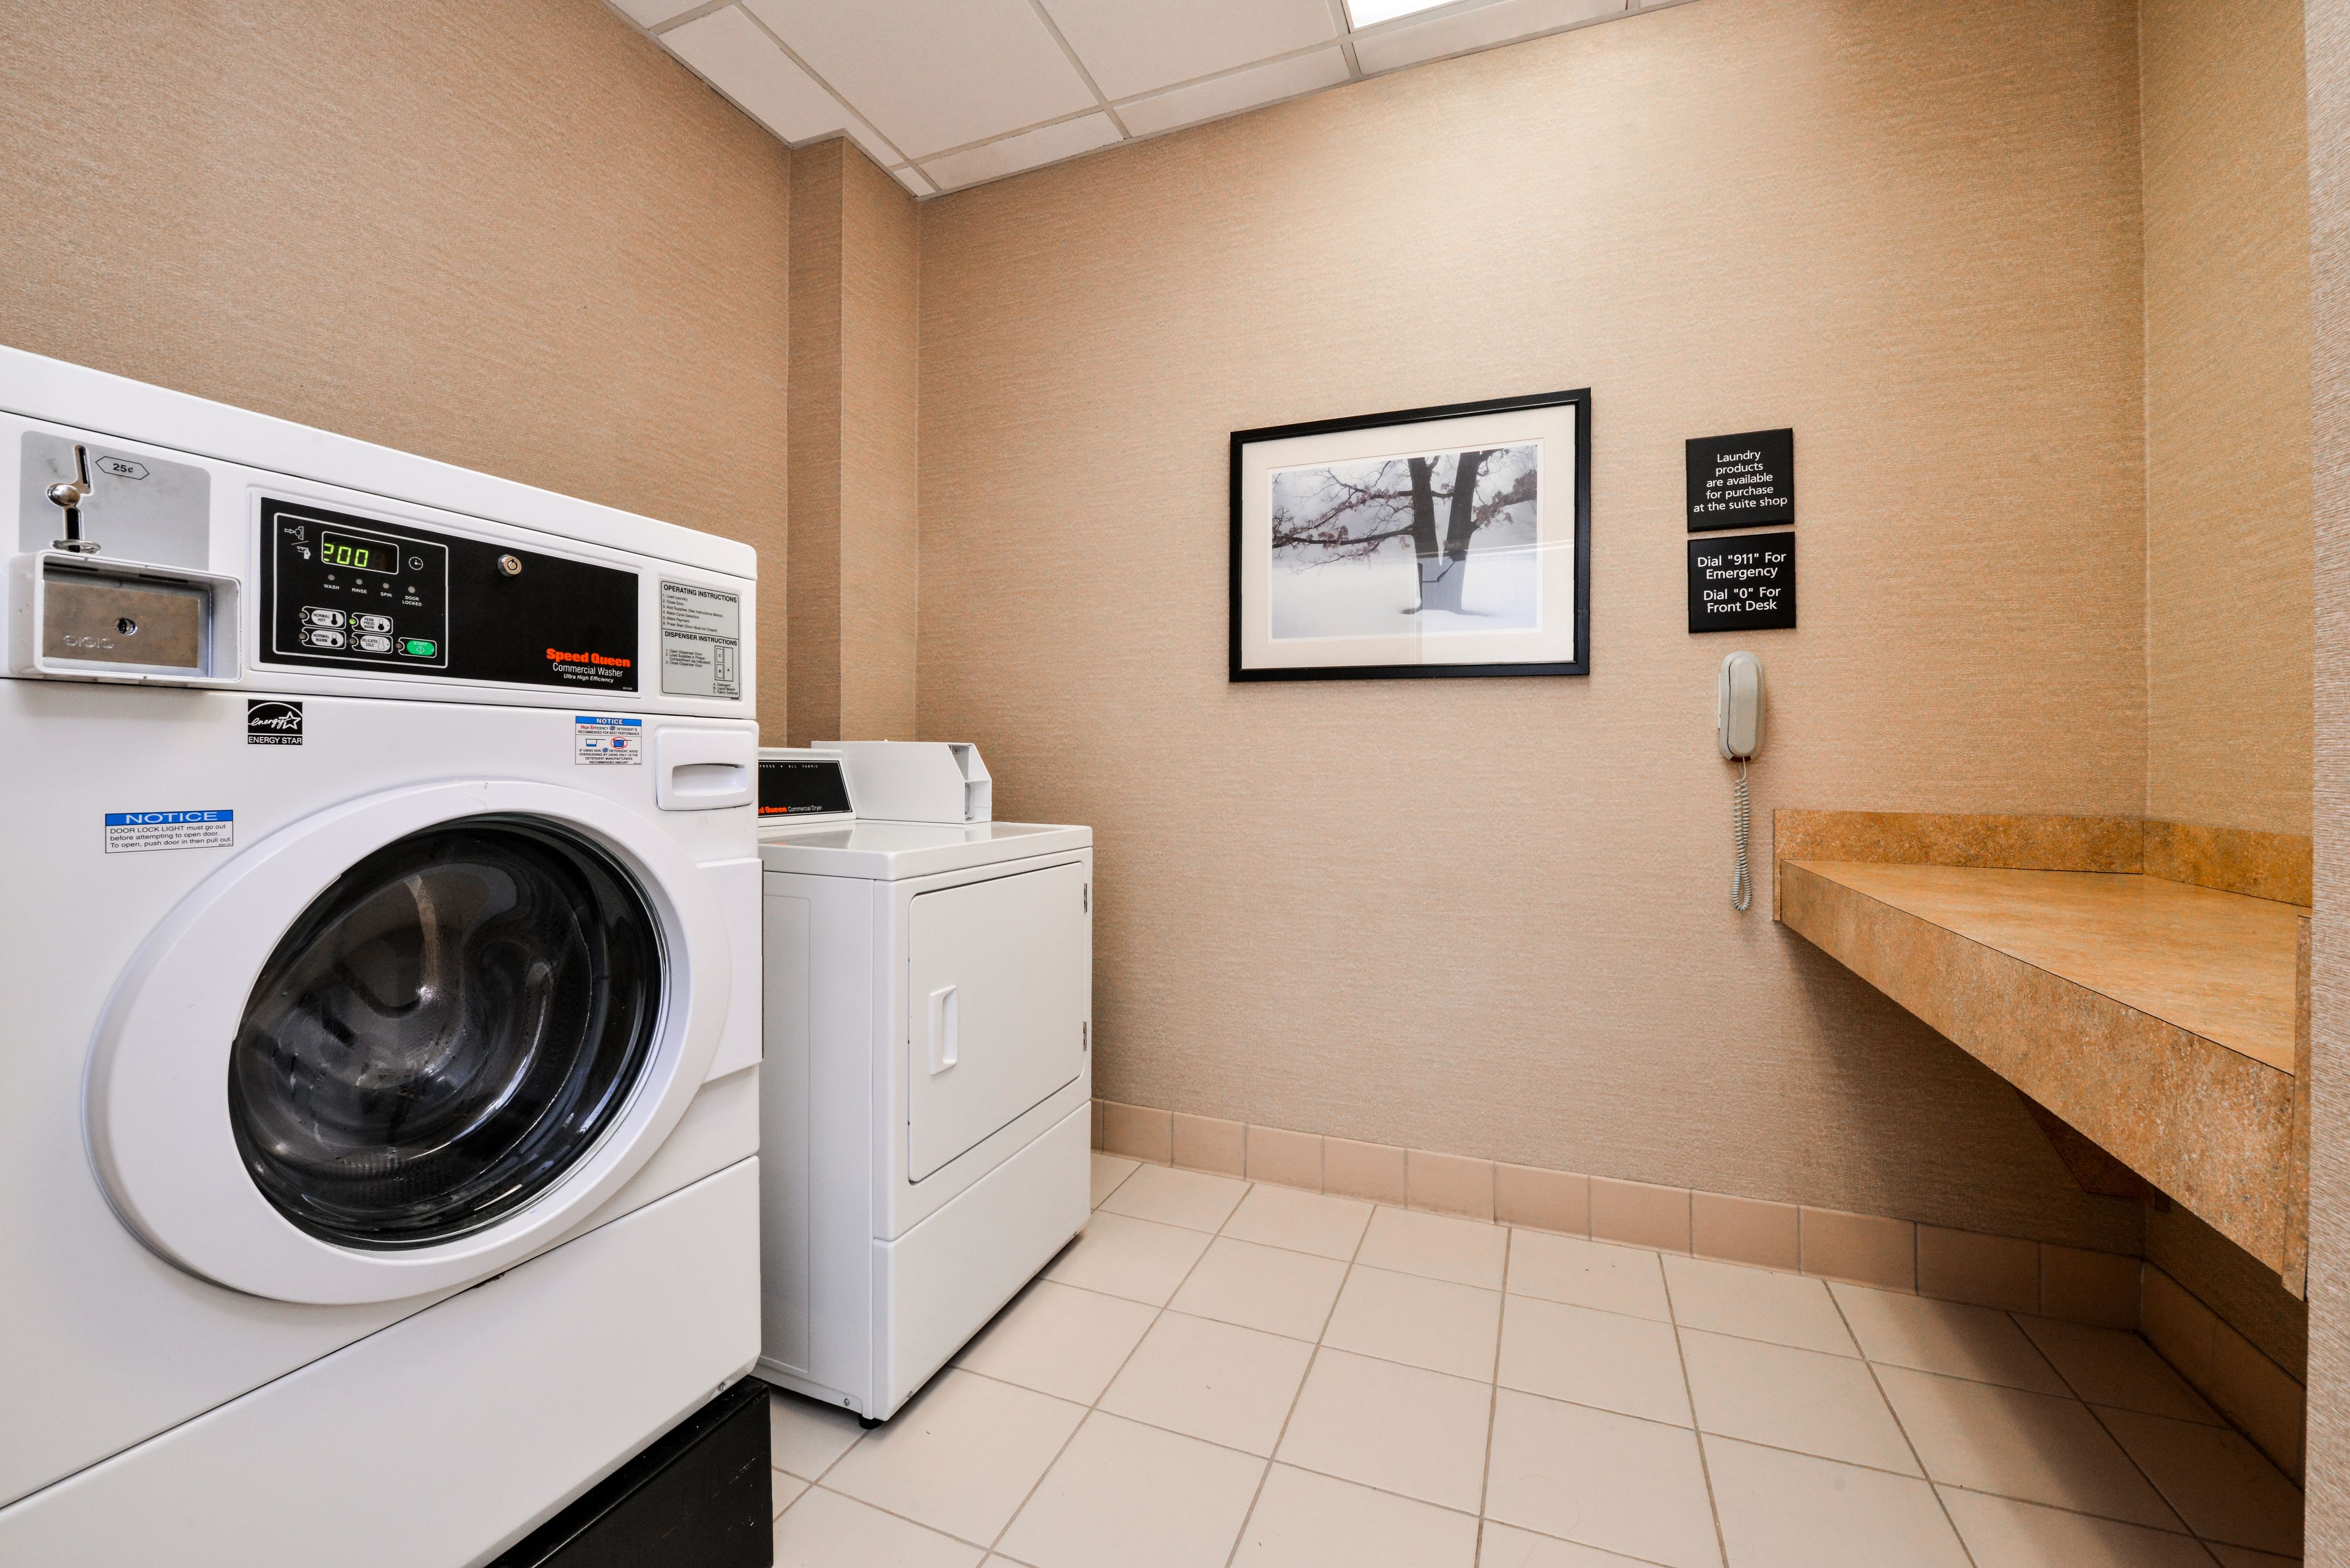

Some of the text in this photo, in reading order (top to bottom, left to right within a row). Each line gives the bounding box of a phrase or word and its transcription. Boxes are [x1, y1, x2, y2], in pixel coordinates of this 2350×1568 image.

[1717, 450, 1761, 462] Laundry
[113, 463, 133, 473] 25¢
[1715, 463, 1764, 477] products
[1726, 472, 1773, 485] available
[1706, 486, 1774, 499] for purchase
[1693, 497, 1788, 512] at the suite shop
[324, 543, 368, 567] 200
[1698, 552, 1786, 567] Dial "911" For
[1706, 567, 1778, 580] Emergency
[663, 584, 737, 603] OPERATING INSTRUCTIONS
[1704, 587, 1781, 600] Dial "0" For
[1707, 599, 1777, 613] Front Desk
[665, 631, 737, 646] DISPENSER INSTRUCTIONS
[546, 648, 631, 667] Speed Queen
[553, 662, 623, 678] Commercial Washer
[248, 717, 288, 730] energy
[126, 812, 218, 824] NOTICE
